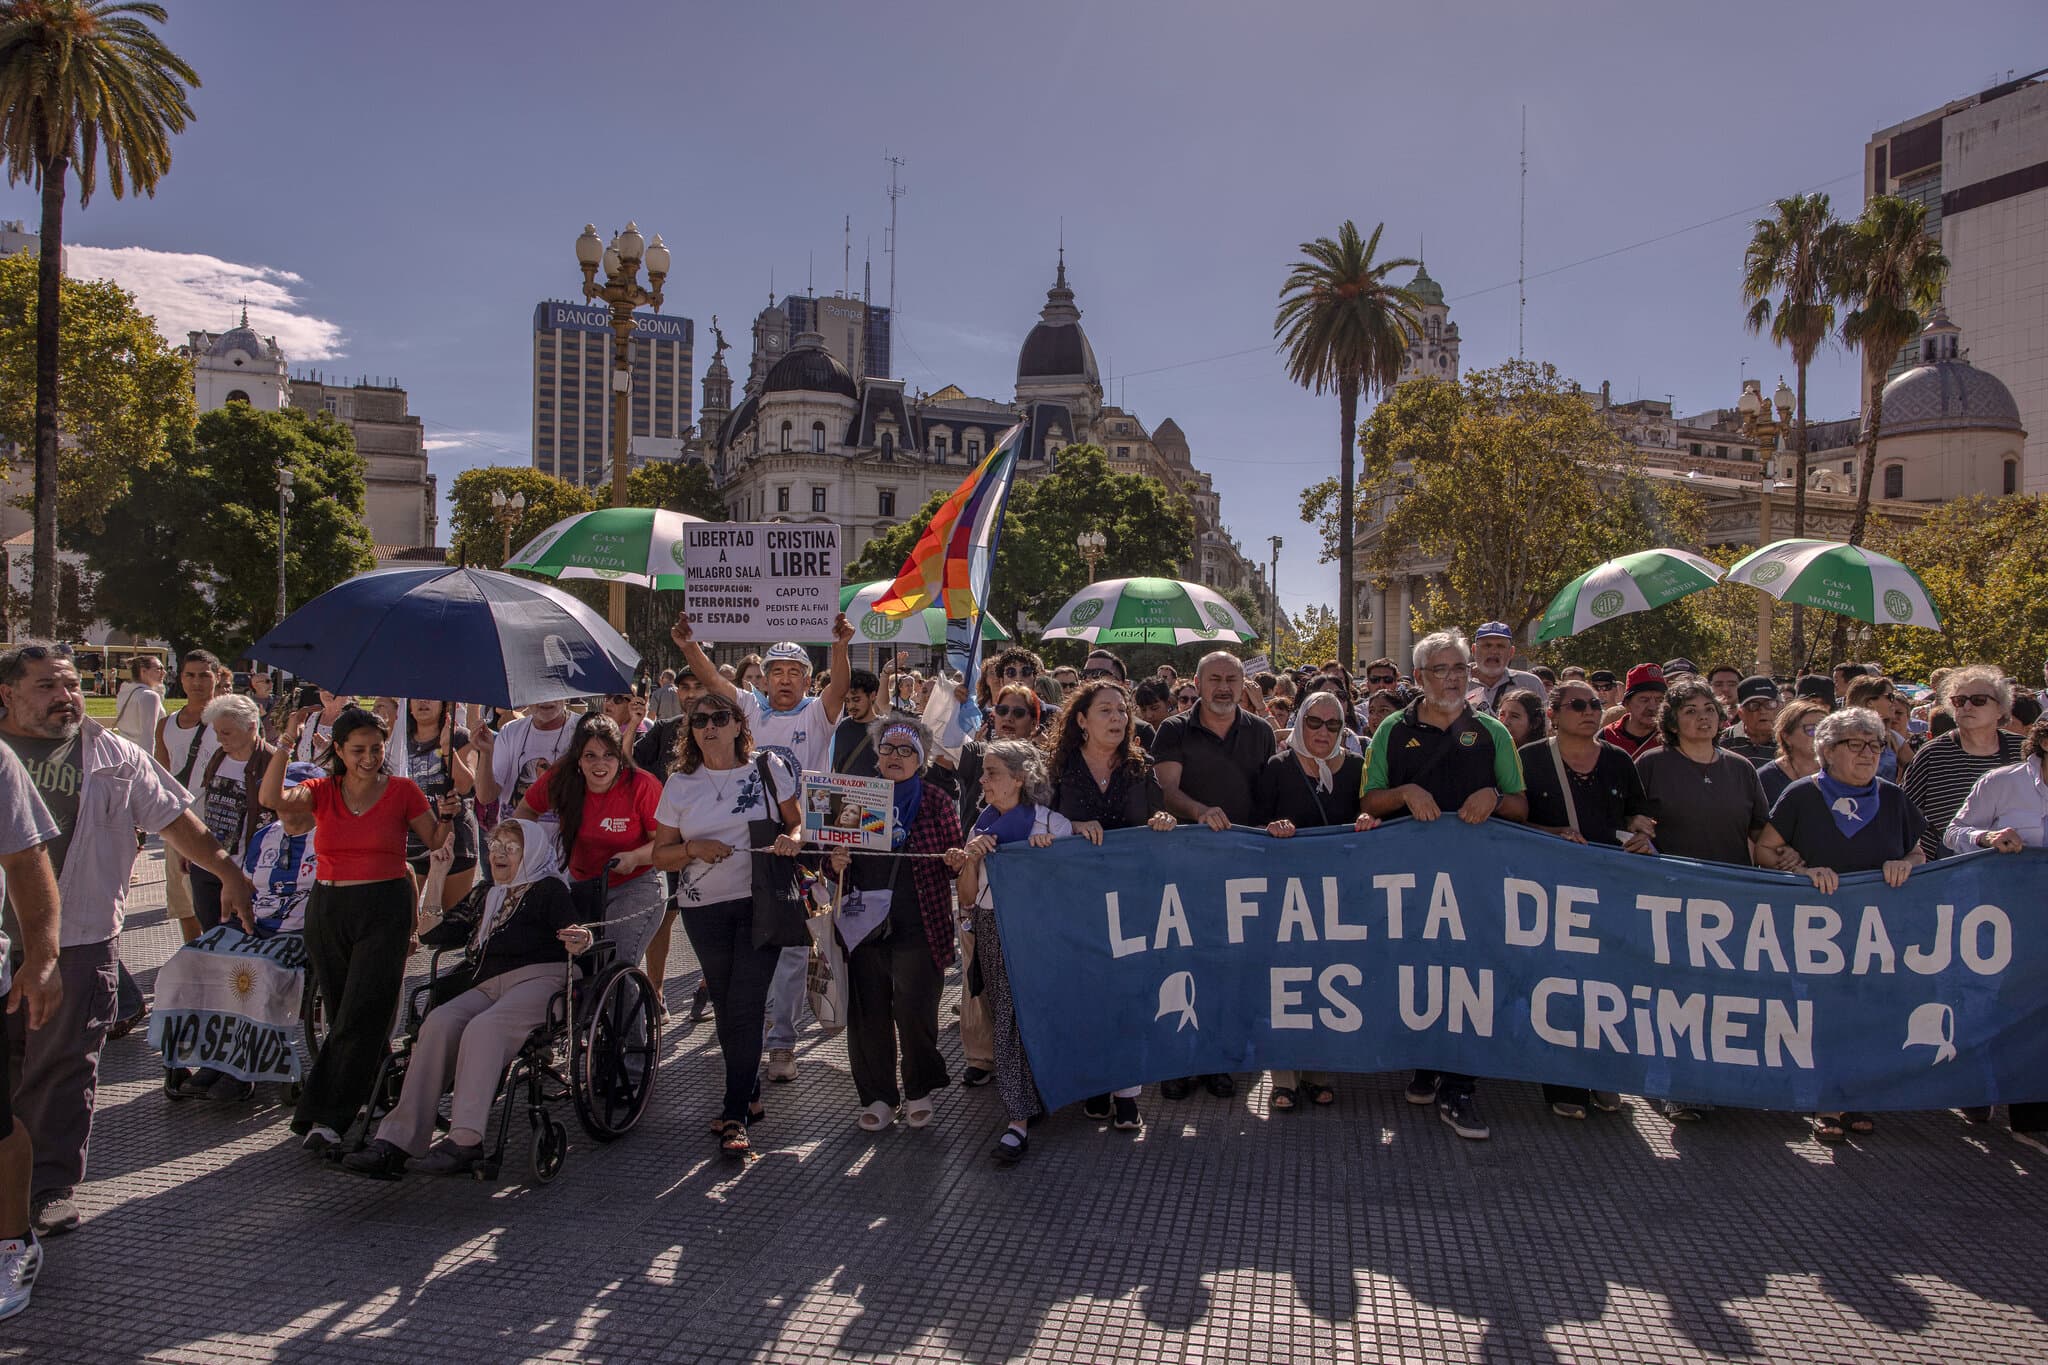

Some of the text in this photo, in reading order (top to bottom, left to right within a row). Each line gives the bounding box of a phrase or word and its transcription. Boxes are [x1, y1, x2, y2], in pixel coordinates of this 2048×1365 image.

[592, 534, 625, 544] CASA
[689, 530, 754, 547] LIBERTAD
[594, 545, 614, 553] DE
[569, 553, 626, 568] MONEDA
[719, 549, 727, 563] A
[771, 551, 831, 577] LIBRE
[688, 566, 761, 579] MILAGRO SALA
[1822, 578, 1852, 591] CASA
[776, 587, 819, 597] CAPUTO
[1826, 589, 1843, 599] DE
[689, 597, 760, 608] TERRORISMO
[766, 603, 829, 612] PEDISTE AL FMI
[1807, 595, 1855, 613] MONEDA
[689, 613, 750, 624] DE ESTADO
[766, 618, 829, 626] VOS LO PAGAS
[1135, 616, 1184, 625] MONEDA
[1105, 871, 2013, 976] LA FALTA DE TRABAJO
[1270, 963, 1364, 1033] ES
[1398, 965, 1495, 1038] UN
[161, 1013, 200, 1062] NO
[200, 1014, 237, 1063] SE
